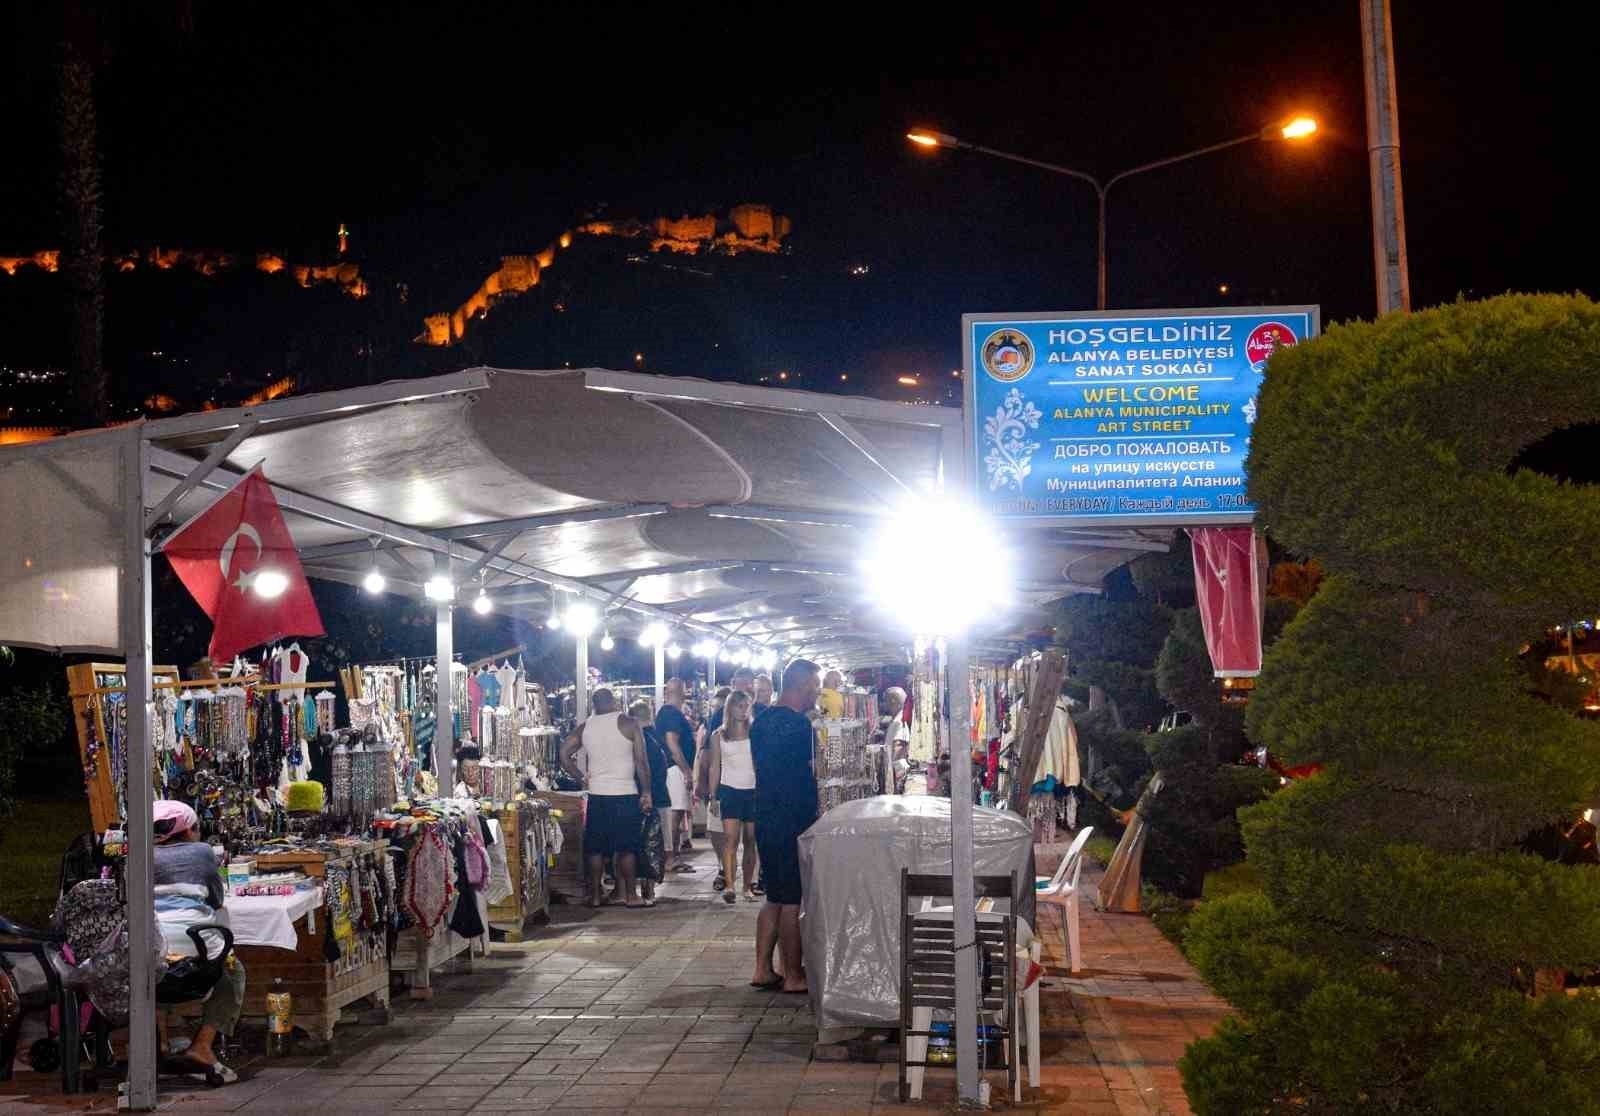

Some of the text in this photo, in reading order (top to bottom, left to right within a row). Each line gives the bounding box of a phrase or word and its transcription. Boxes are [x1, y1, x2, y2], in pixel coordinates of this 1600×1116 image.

[1049, 322, 1232, 347] HOŞGELDİNİZ
[1048, 350, 1120, 363] ALANYA
[1126, 344, 1234, 361] BELEDİYESİ
[1075, 361, 1213, 377] SANAT SOKAĞI
[1083, 385, 1200, 403] WELCOME
[1054, 403, 1231, 419] ALANYA MUNICIPALITY
[1097, 420, 1192, 433] ART STREET
[1054, 441, 1231, 460] ДОБРО ПОЖАЛОВАТЬ
[1072, 460, 1216, 476] на улицу искусств
[1047, 475, 1241, 493] Муниципалитета Алании
